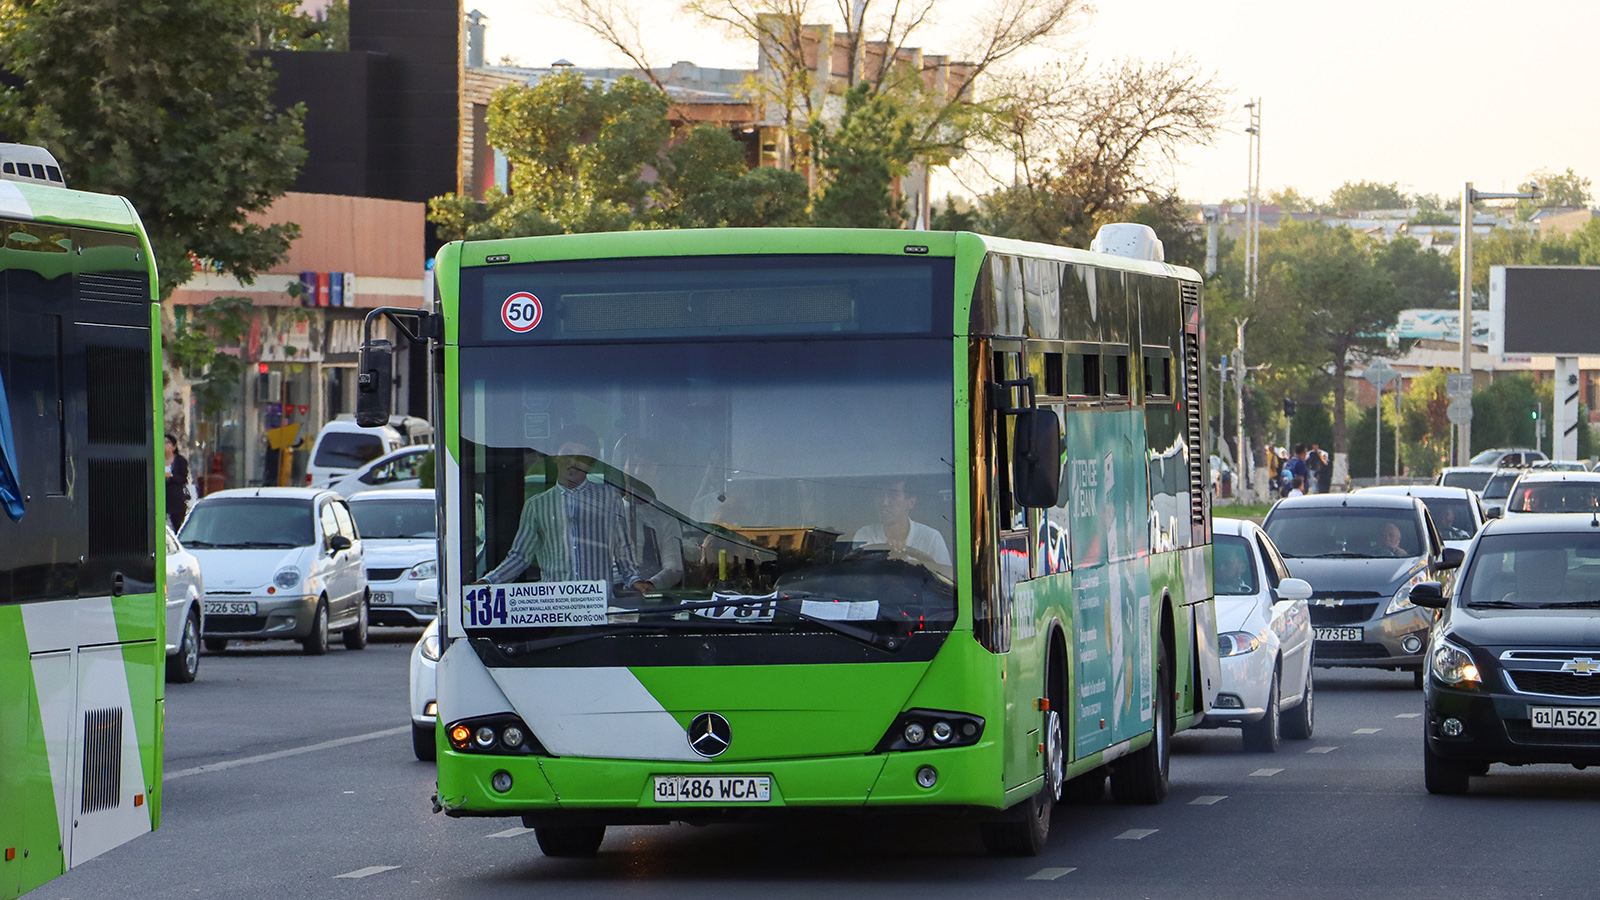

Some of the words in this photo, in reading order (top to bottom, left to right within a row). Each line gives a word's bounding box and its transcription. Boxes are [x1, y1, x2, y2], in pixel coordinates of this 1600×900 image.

[509, 303, 535, 321] 50
[1080, 489, 1098, 518] BANK
[509, 585, 556, 597] JANUBIY
[558, 584, 603, 595] VOKZAL
[210, 603, 228, 613] 226
[230, 603, 250, 613] SGA
[466, 588, 508, 626] 134
[511, 612, 572, 624] NAZARBEK
[1534, 711, 1551, 724] 01
[658, 781, 676, 797] 01
[679, 779, 714, 799] 486
[719, 779, 758, 799] WCA
